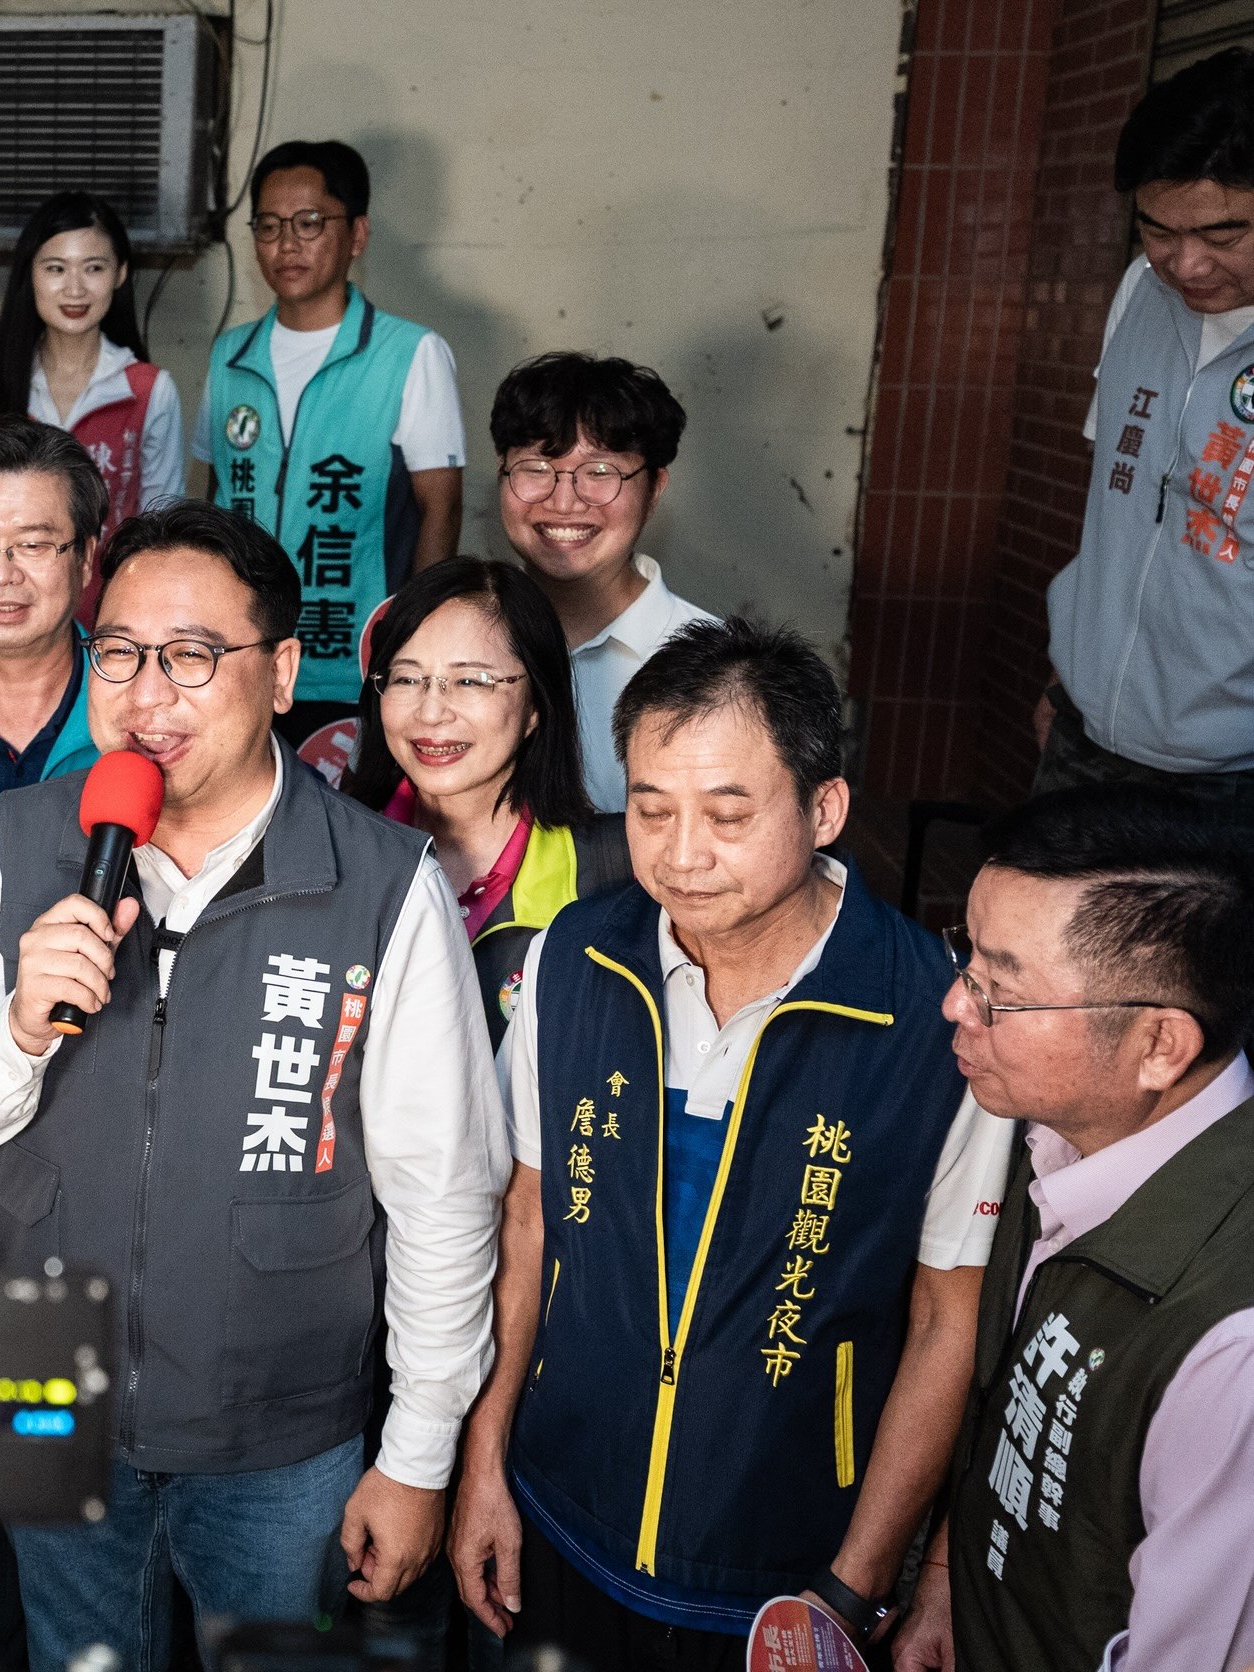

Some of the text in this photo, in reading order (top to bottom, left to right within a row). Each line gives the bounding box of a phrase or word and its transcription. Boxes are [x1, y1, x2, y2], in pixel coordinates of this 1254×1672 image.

[296, 454, 366, 660] 余信憲
[239, 953, 331, 1172] 黃世杰
[562, 1097, 597, 1224] 詹德男
[601, 1070, 630, 1140] 會長
[760, 1113, 852, 1389] 桃園觀光夜市
[988, 1312, 1081, 1531] 許清順
[1037, 1367, 1088, 1532] 執行副總幹事
